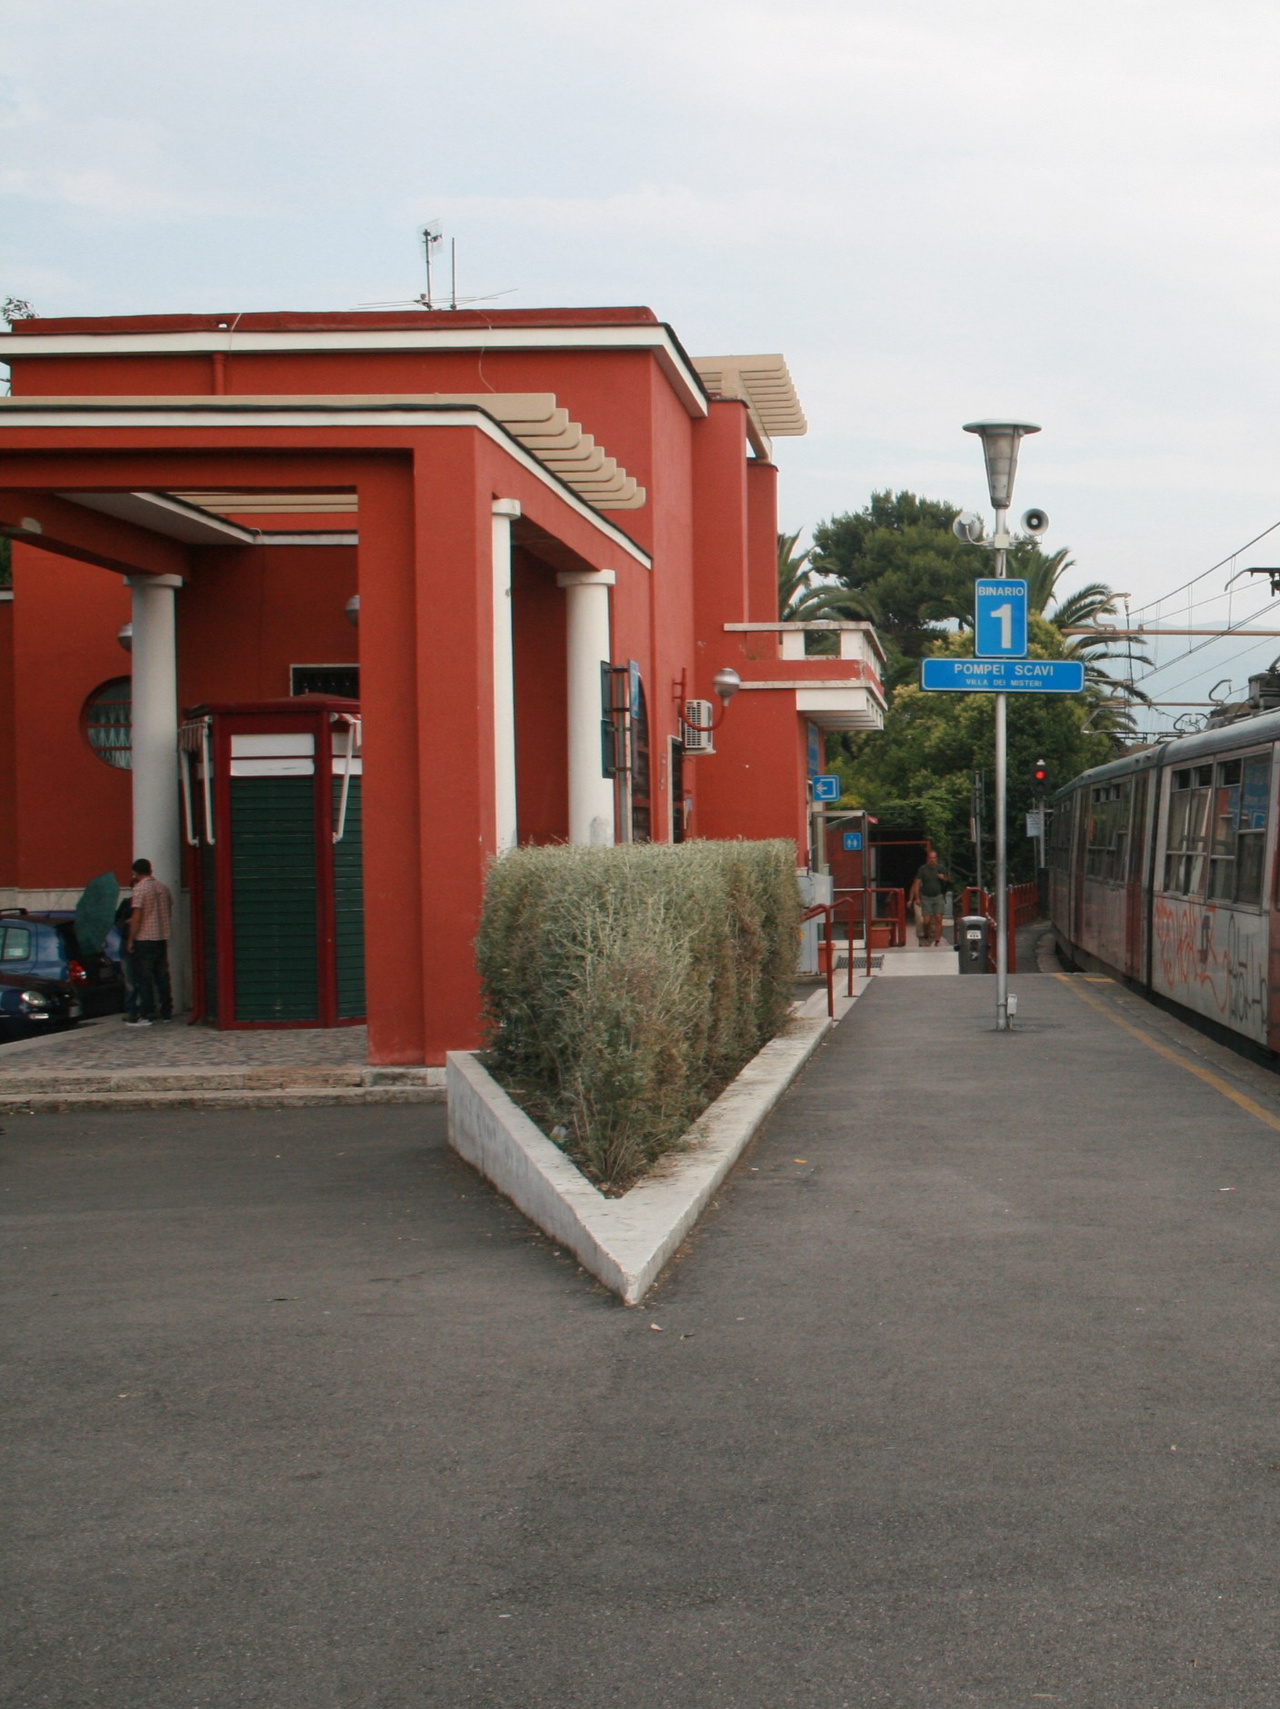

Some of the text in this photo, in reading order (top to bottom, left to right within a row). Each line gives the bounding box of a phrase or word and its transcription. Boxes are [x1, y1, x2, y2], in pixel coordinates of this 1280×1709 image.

[978, 586, 1025, 597] BINARIO
[990, 603, 1012, 649] 1
[954, 663, 1054, 676] POMPEI SCAVI
[965, 678, 988, 686] VILLA
[1010, 679, 1042, 687] MISTERI
